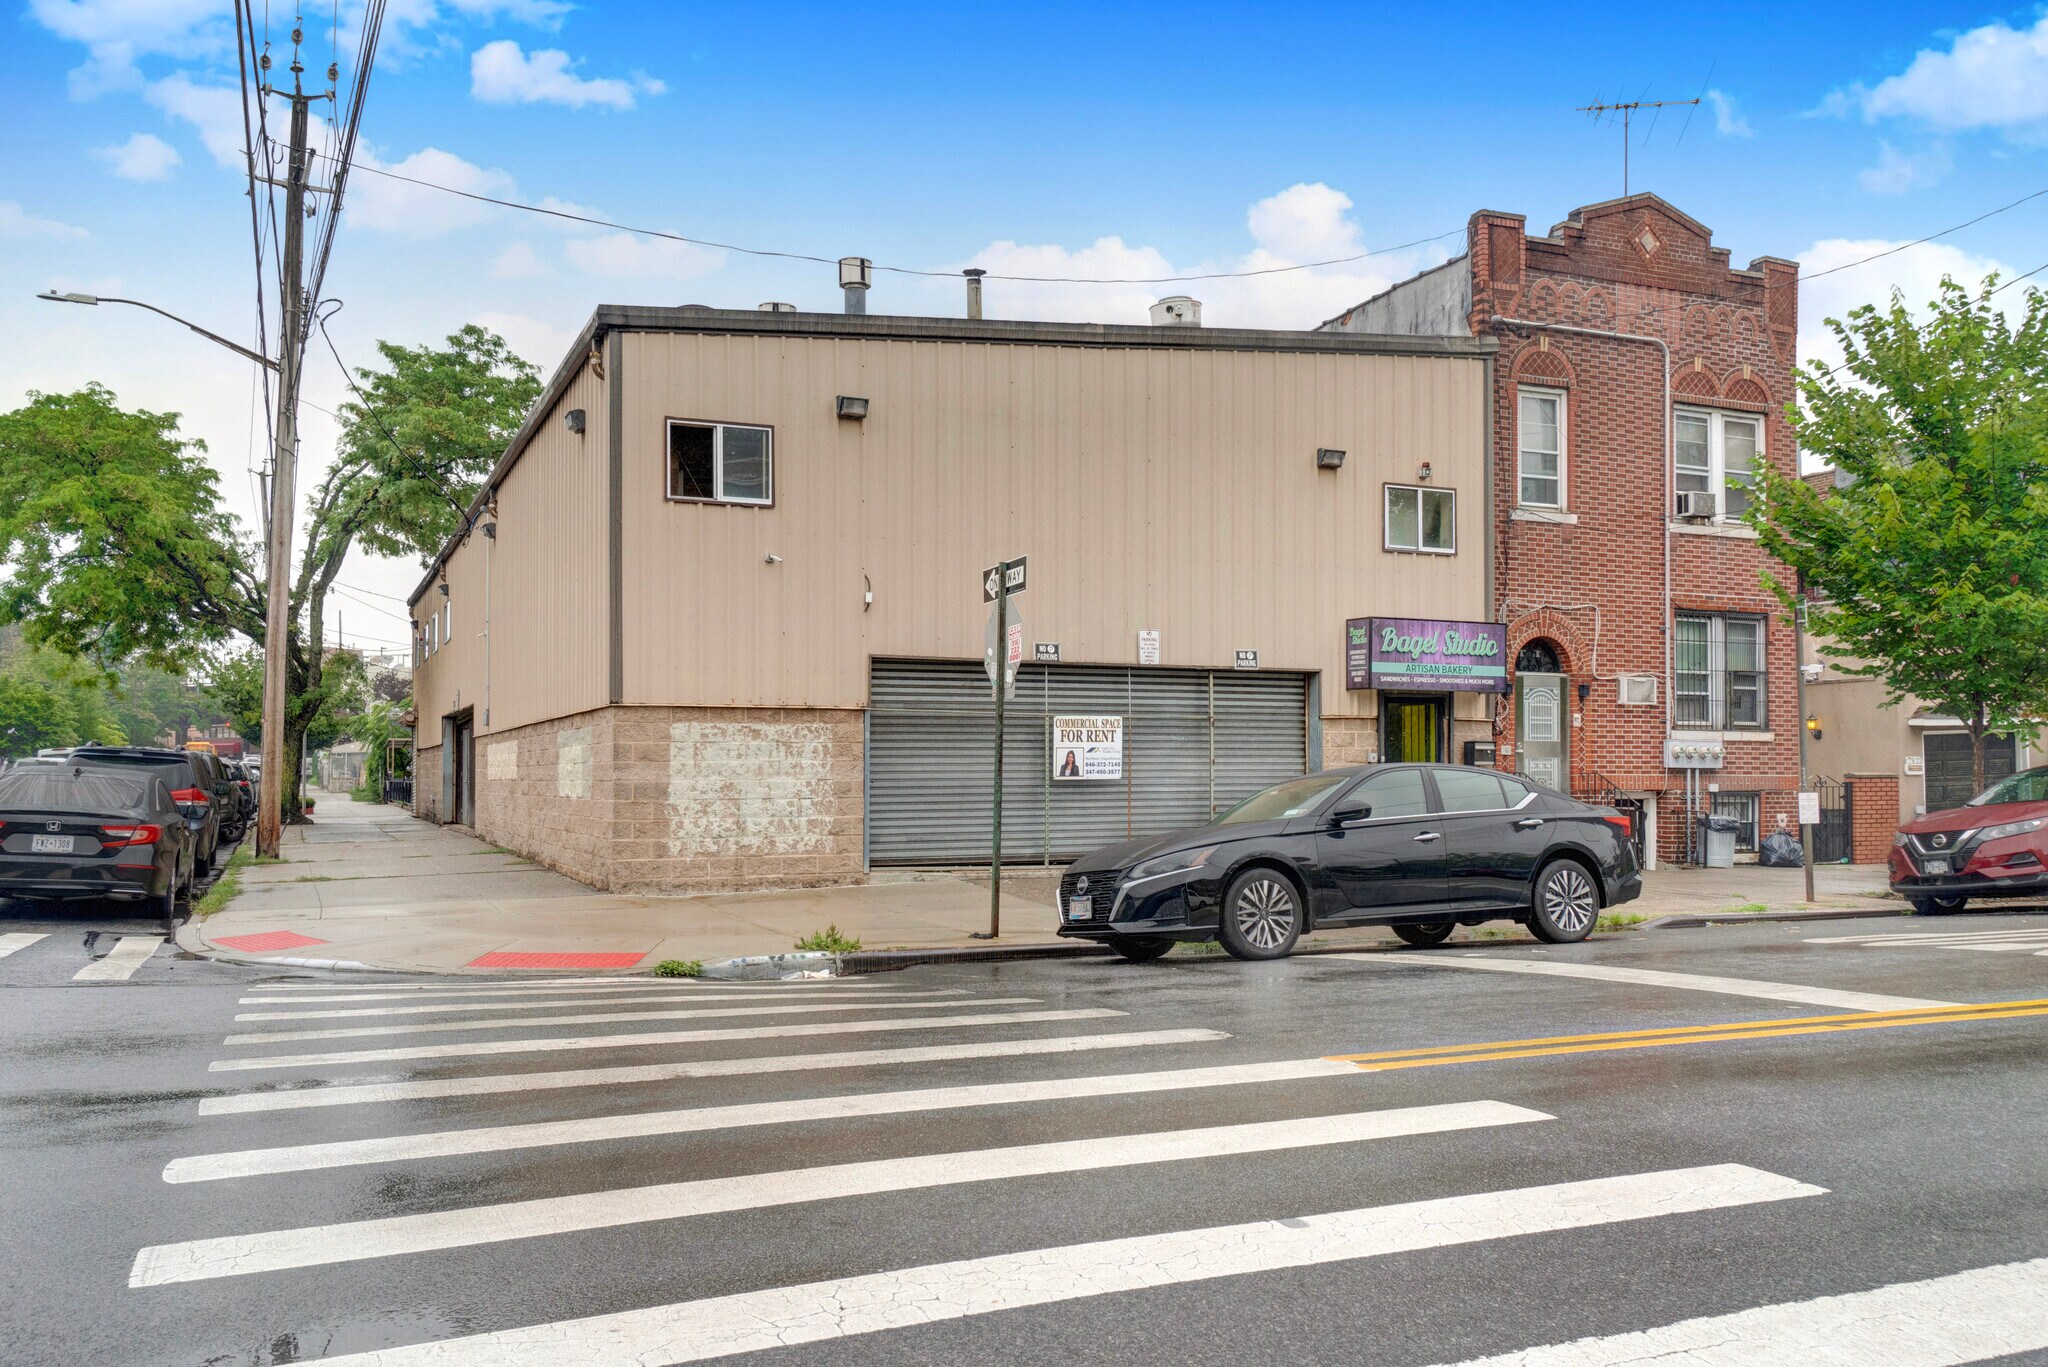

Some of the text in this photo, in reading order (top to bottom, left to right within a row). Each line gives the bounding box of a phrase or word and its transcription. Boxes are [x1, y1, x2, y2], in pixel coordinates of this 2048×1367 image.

[1007, 568, 1022, 585] WAY
[1381, 627, 1499, 660] Bagel Studio
[1037, 652, 1058, 661] PARKING
[1238, 659, 1256, 667] PARKING
[1405, 664, 1473, 675] ARTISAN BAKERY
[1380, 675, 1411, 683] SANDWICHES
[1055, 718, 1121, 729] COMMERCIAL SPACE
[1060, 729, 1116, 743] FOR RENT
